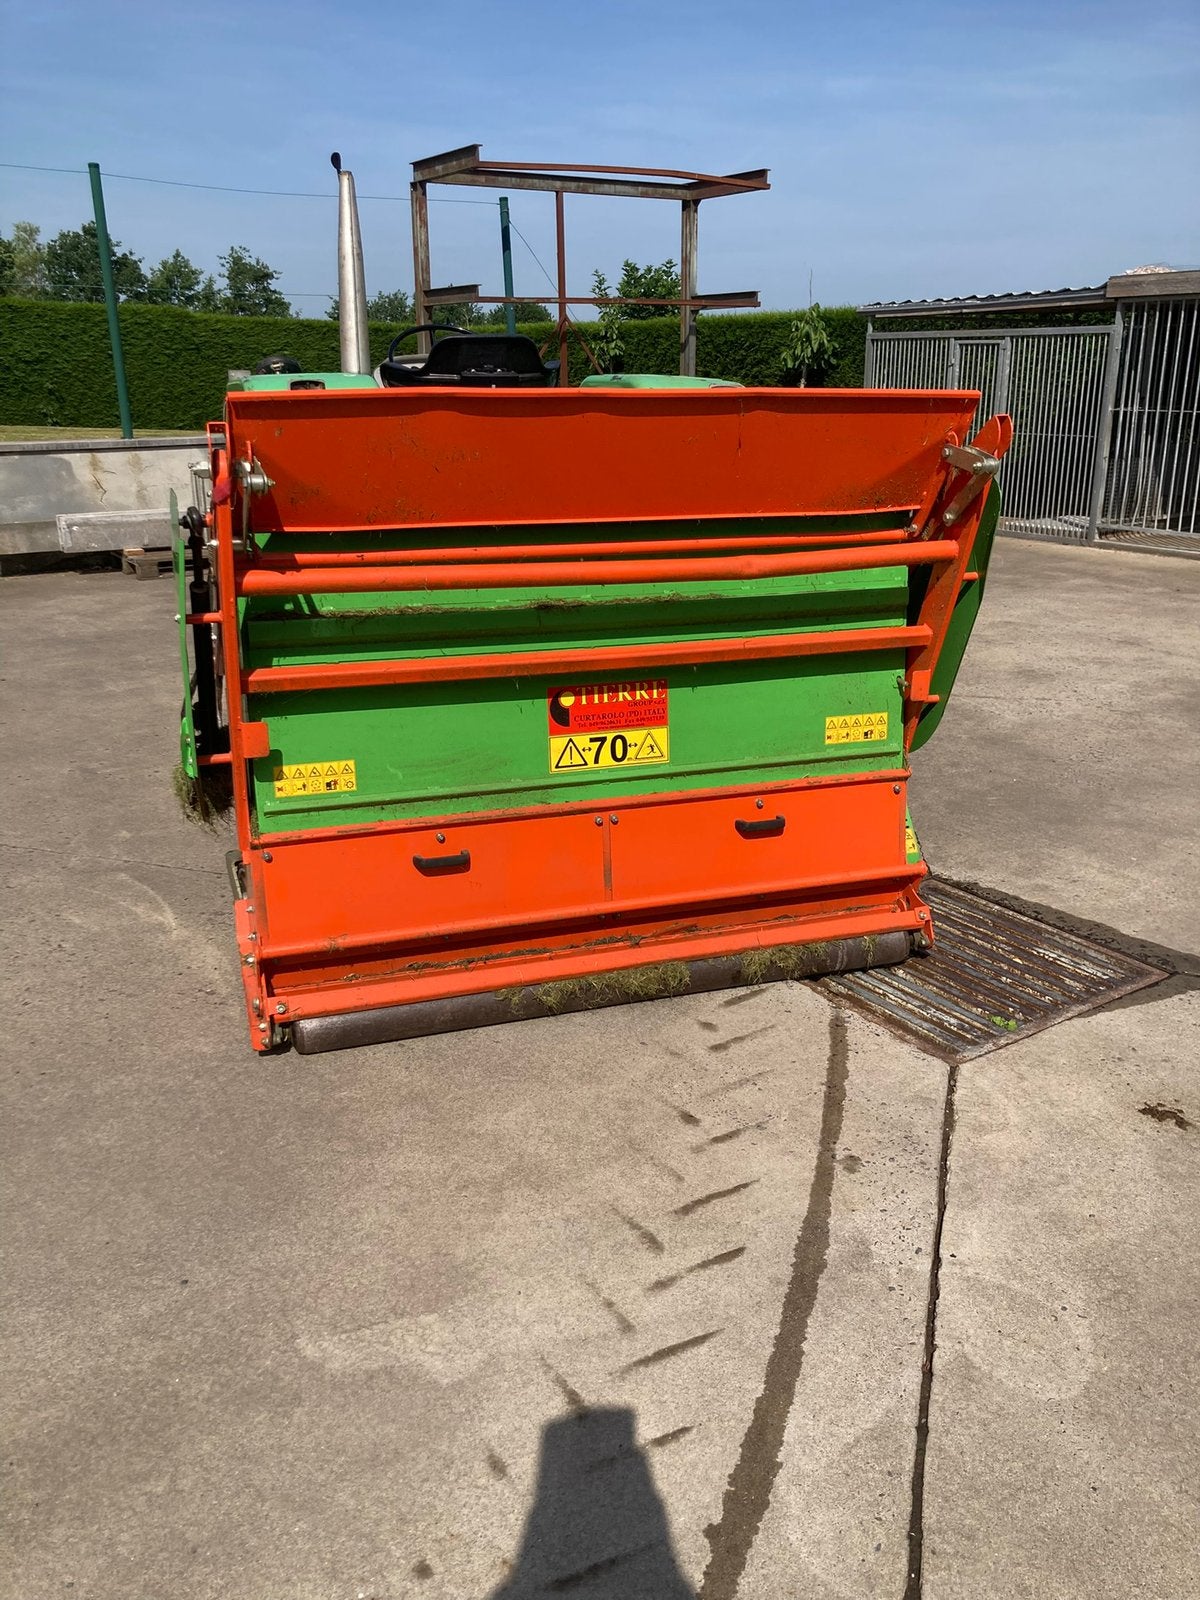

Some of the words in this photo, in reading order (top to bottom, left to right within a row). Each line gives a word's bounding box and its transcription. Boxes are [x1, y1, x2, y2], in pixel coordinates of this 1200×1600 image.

[576, 680, 666, 704] TIERRE
[627, 699, 653, 708] GROUP
[573, 711, 625, 722] CURTAROLO
[626, 709, 642, 719] (PD)
[644, 707, 666, 717] ITALY
[589, 734, 628, 765] 70
